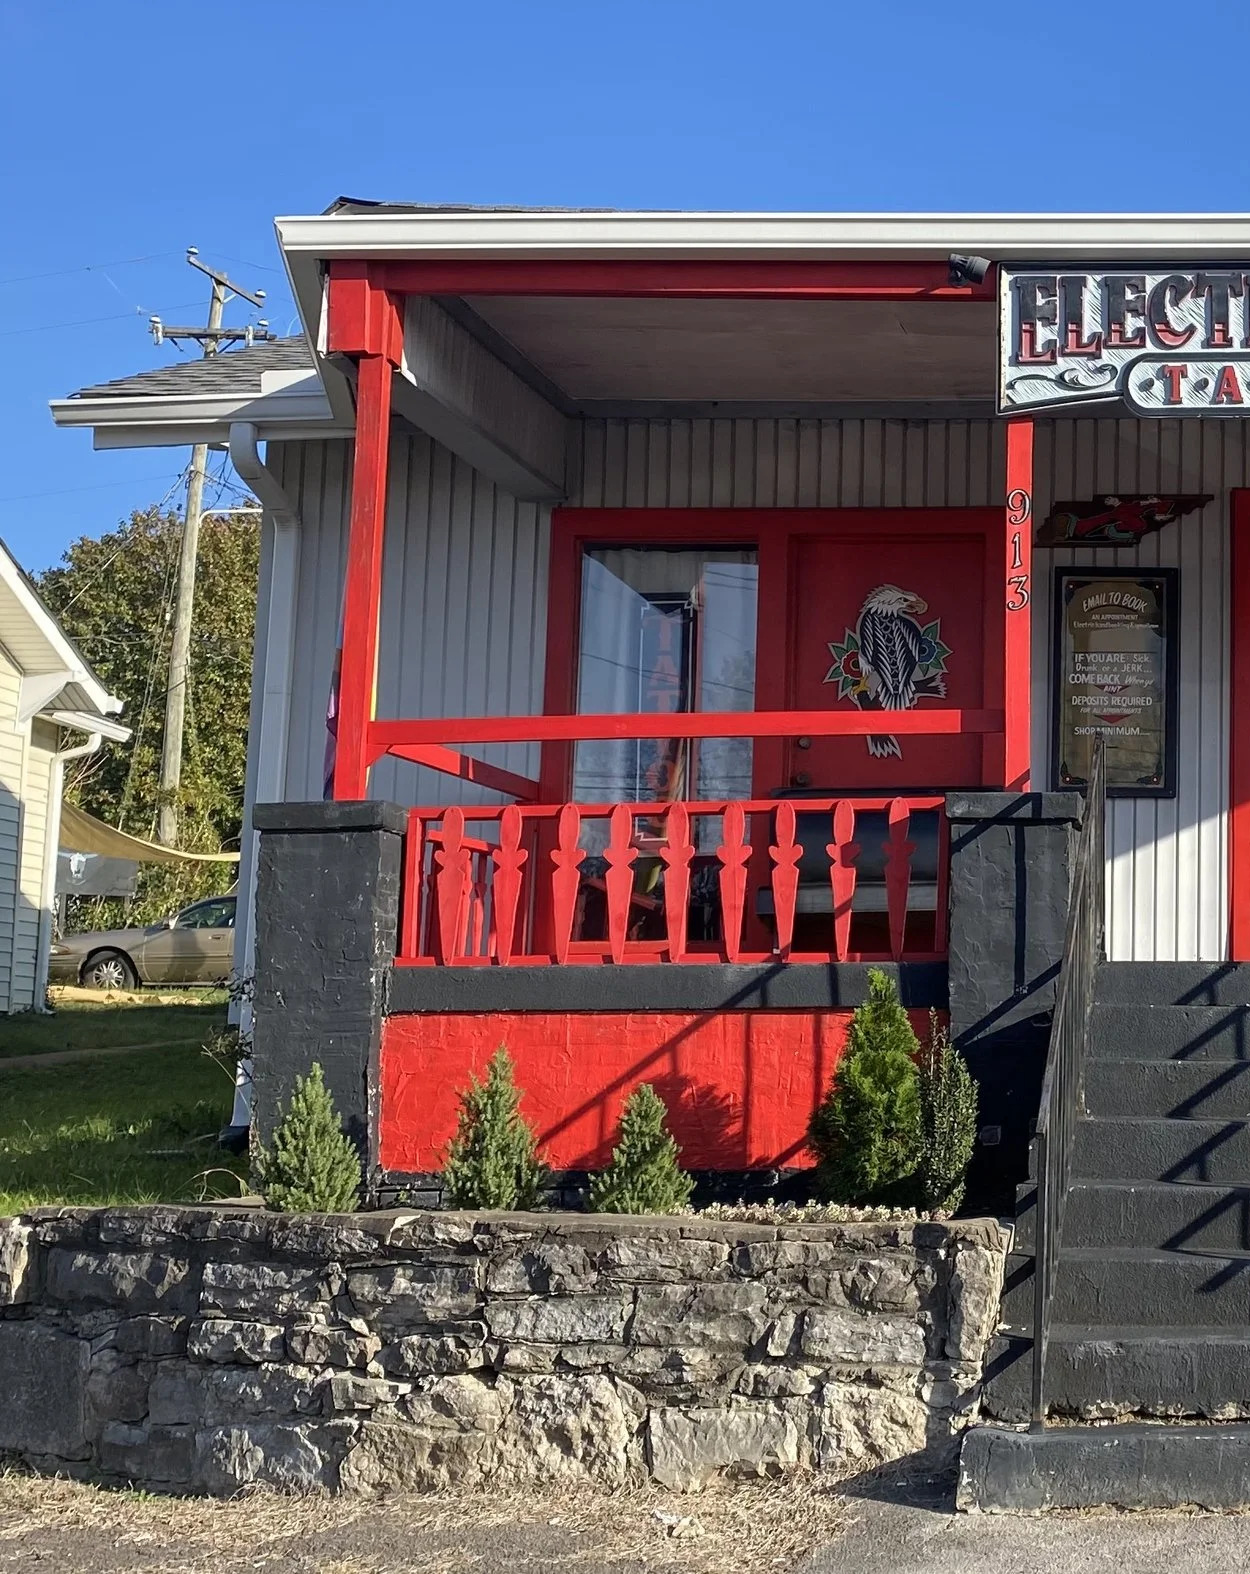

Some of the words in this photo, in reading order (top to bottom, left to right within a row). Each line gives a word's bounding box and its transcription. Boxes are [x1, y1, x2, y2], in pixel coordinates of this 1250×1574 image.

[1006, 488, 1031, 612] 913
[1082, 592, 1108, 612] EMAIL
[1108, 591, 1121, 605] TO
[1121, 593, 1148, 613] BOOK
[1074, 653, 1085, 663] IF
[1086, 653, 1105, 663] YOU
[1075, 663, 1098, 672] Drunk
[1068, 674, 1096, 684] COME
[1097, 674, 1121, 685] BACK
[1071, 696, 1109, 706] DEPOSITS
[1111, 696, 1153, 707] REQUIRED
[1074, 726, 1095, 736] SHOP
